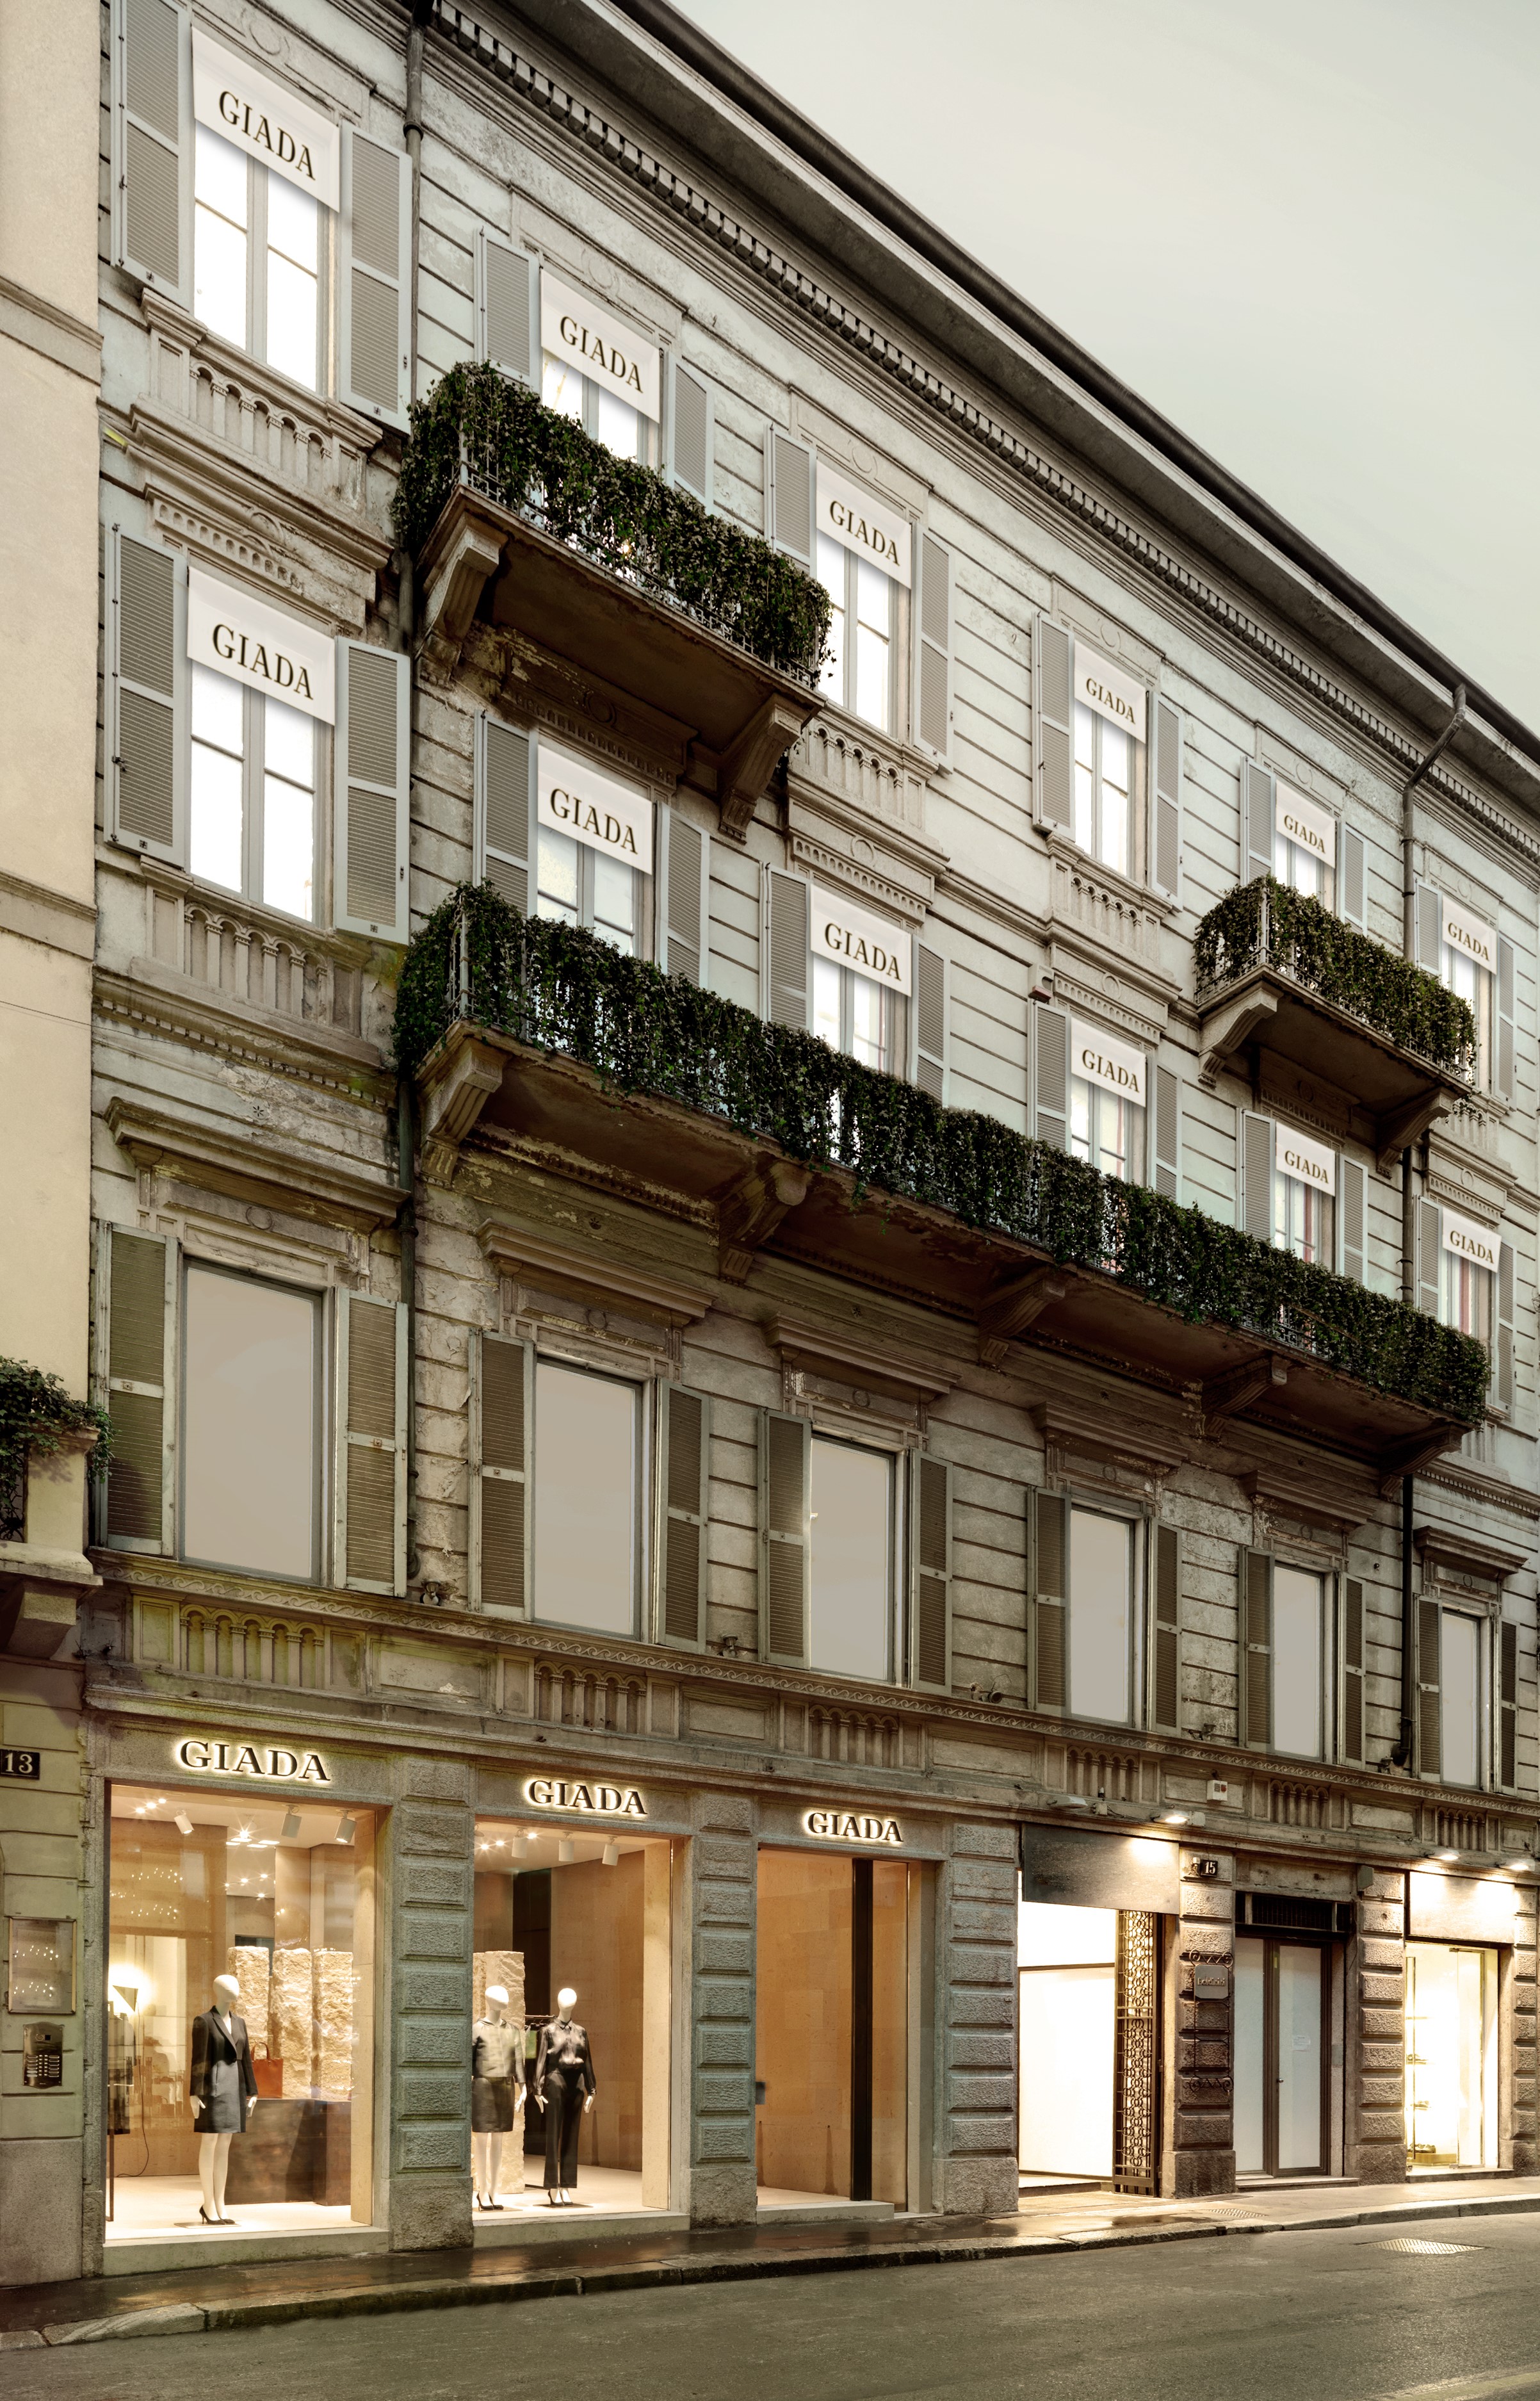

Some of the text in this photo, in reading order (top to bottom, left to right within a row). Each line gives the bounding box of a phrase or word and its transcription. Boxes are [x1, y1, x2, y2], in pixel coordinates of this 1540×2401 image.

[220, 92, 315, 180] GIADA
[560, 316, 642, 393] GIADA
[830, 501, 900, 566] GIADA
[213, 624, 313, 699] GIADA
[1087, 678, 1135, 724] GIADA
[551, 789, 637, 854] GIADA
[1285, 815, 1325, 853] GIADA
[825, 924, 901, 981] GIADA
[1448, 923, 1489, 961] GIADA
[1082, 1050, 1139, 1093] GIADA
[1285, 1151, 1328, 1184] GIADA
[1450, 1231, 1493, 1264] GIADA
[4, 1752, 33, 1773] 13
[179, 1741, 330, 1781] GIADA
[528, 1780, 647, 1815] GIADA
[807, 1812, 904, 1842] GIADA
[1204, 1861, 1216, 1875] 15
